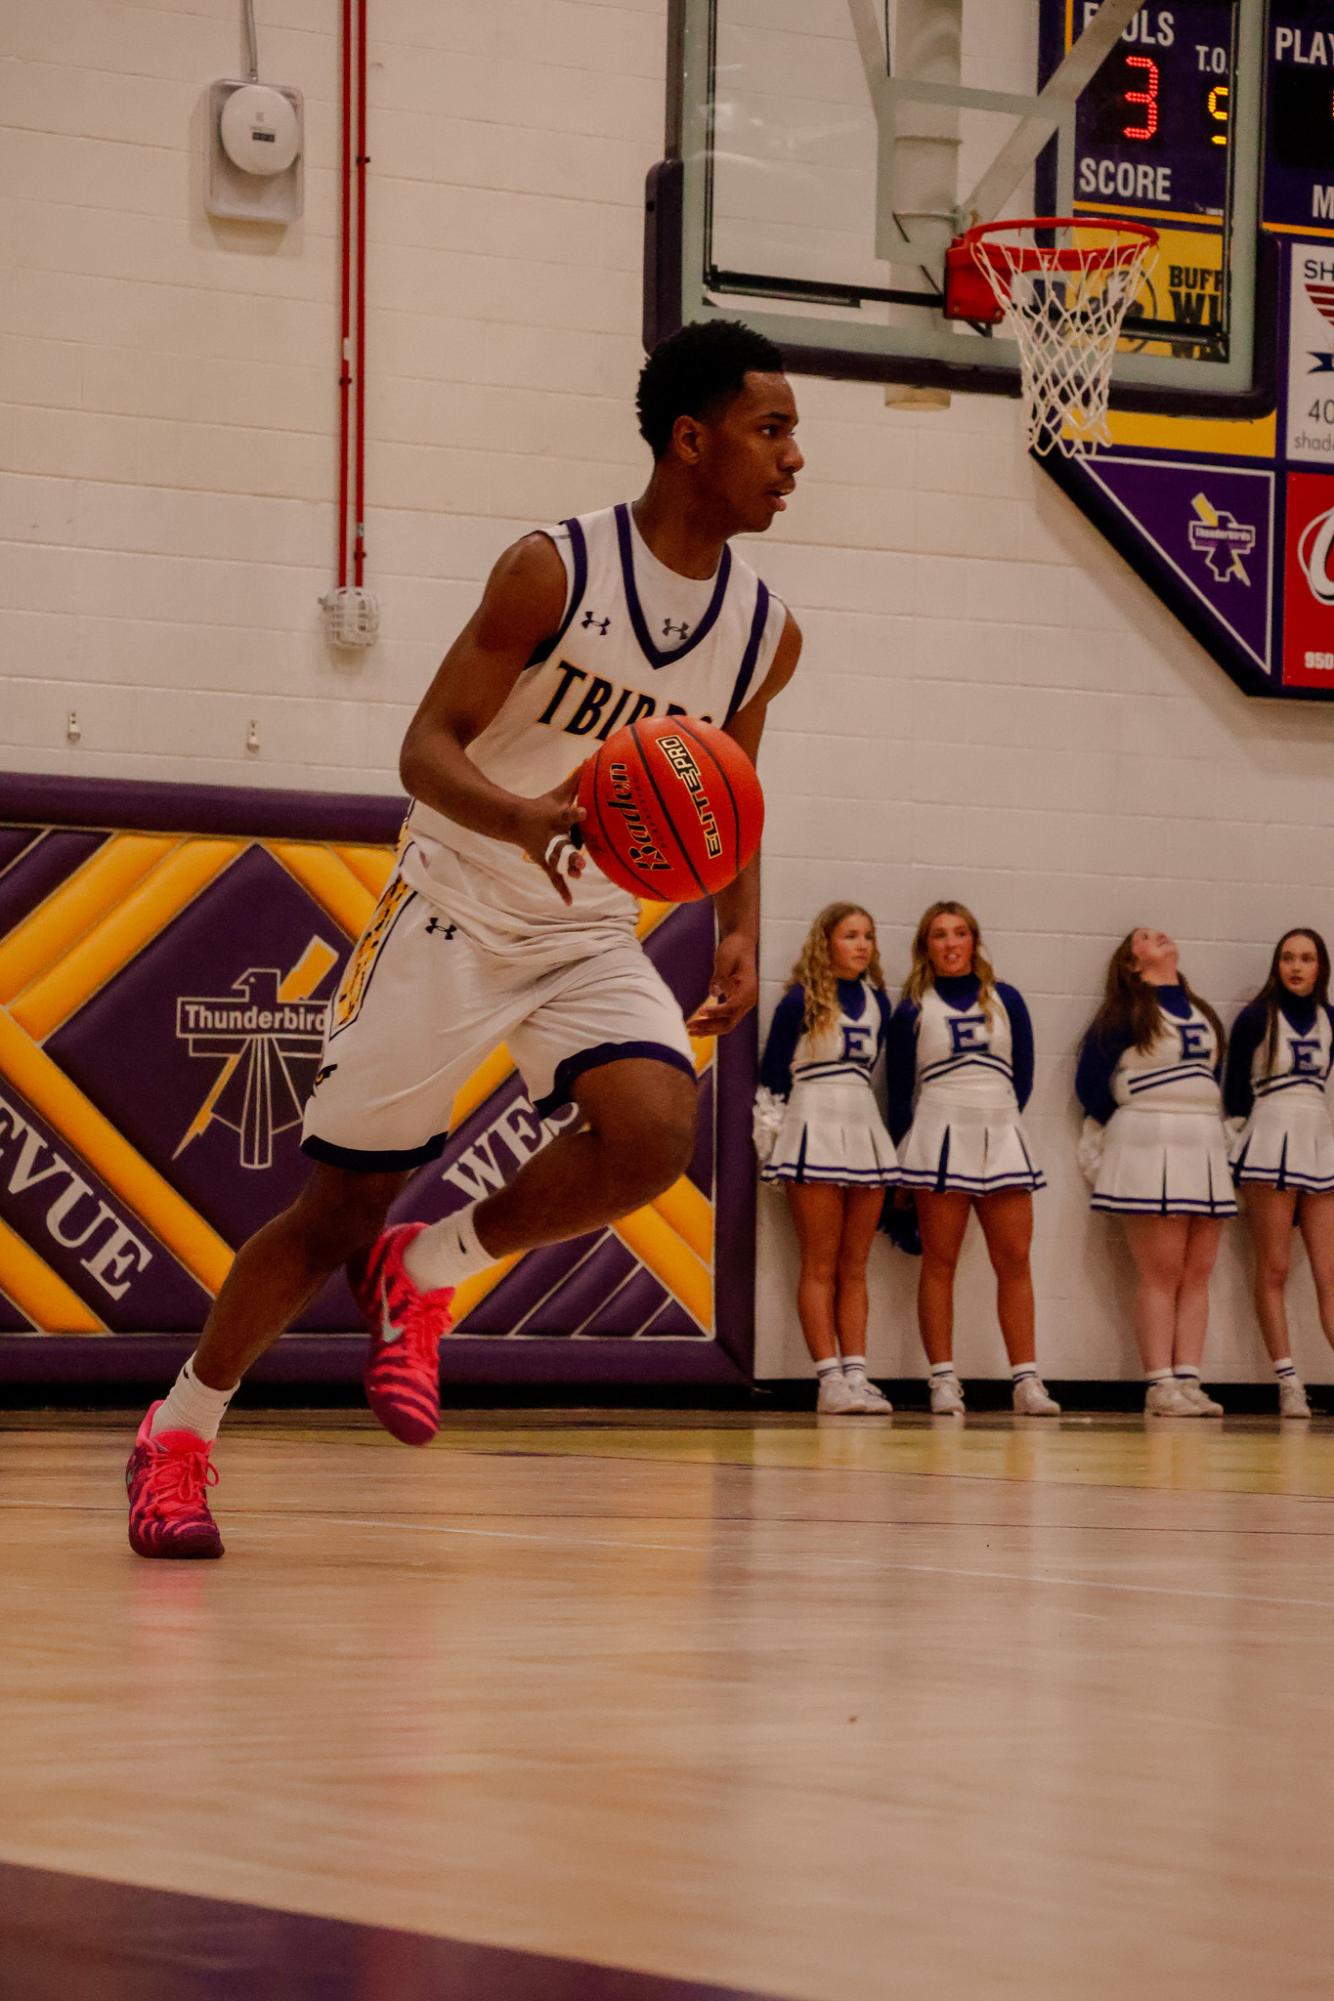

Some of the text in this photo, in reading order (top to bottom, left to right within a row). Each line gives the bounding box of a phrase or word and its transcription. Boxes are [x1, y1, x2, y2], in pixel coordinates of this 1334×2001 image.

[1083, 1, 1174, 47] FULS
[1124, 55, 1159, 140] 3
[1080, 156, 1172, 201] SCORE
[537, 659, 713, 742] TBIR
[607, 762, 675, 870] Baden
[680, 768, 723, 859] ELITE
[839, 1024, 872, 1065] E
[945, 1014, 989, 1055] E
[1176, 1023, 1213, 1061] E
[1287, 1038, 1322, 1077] E
